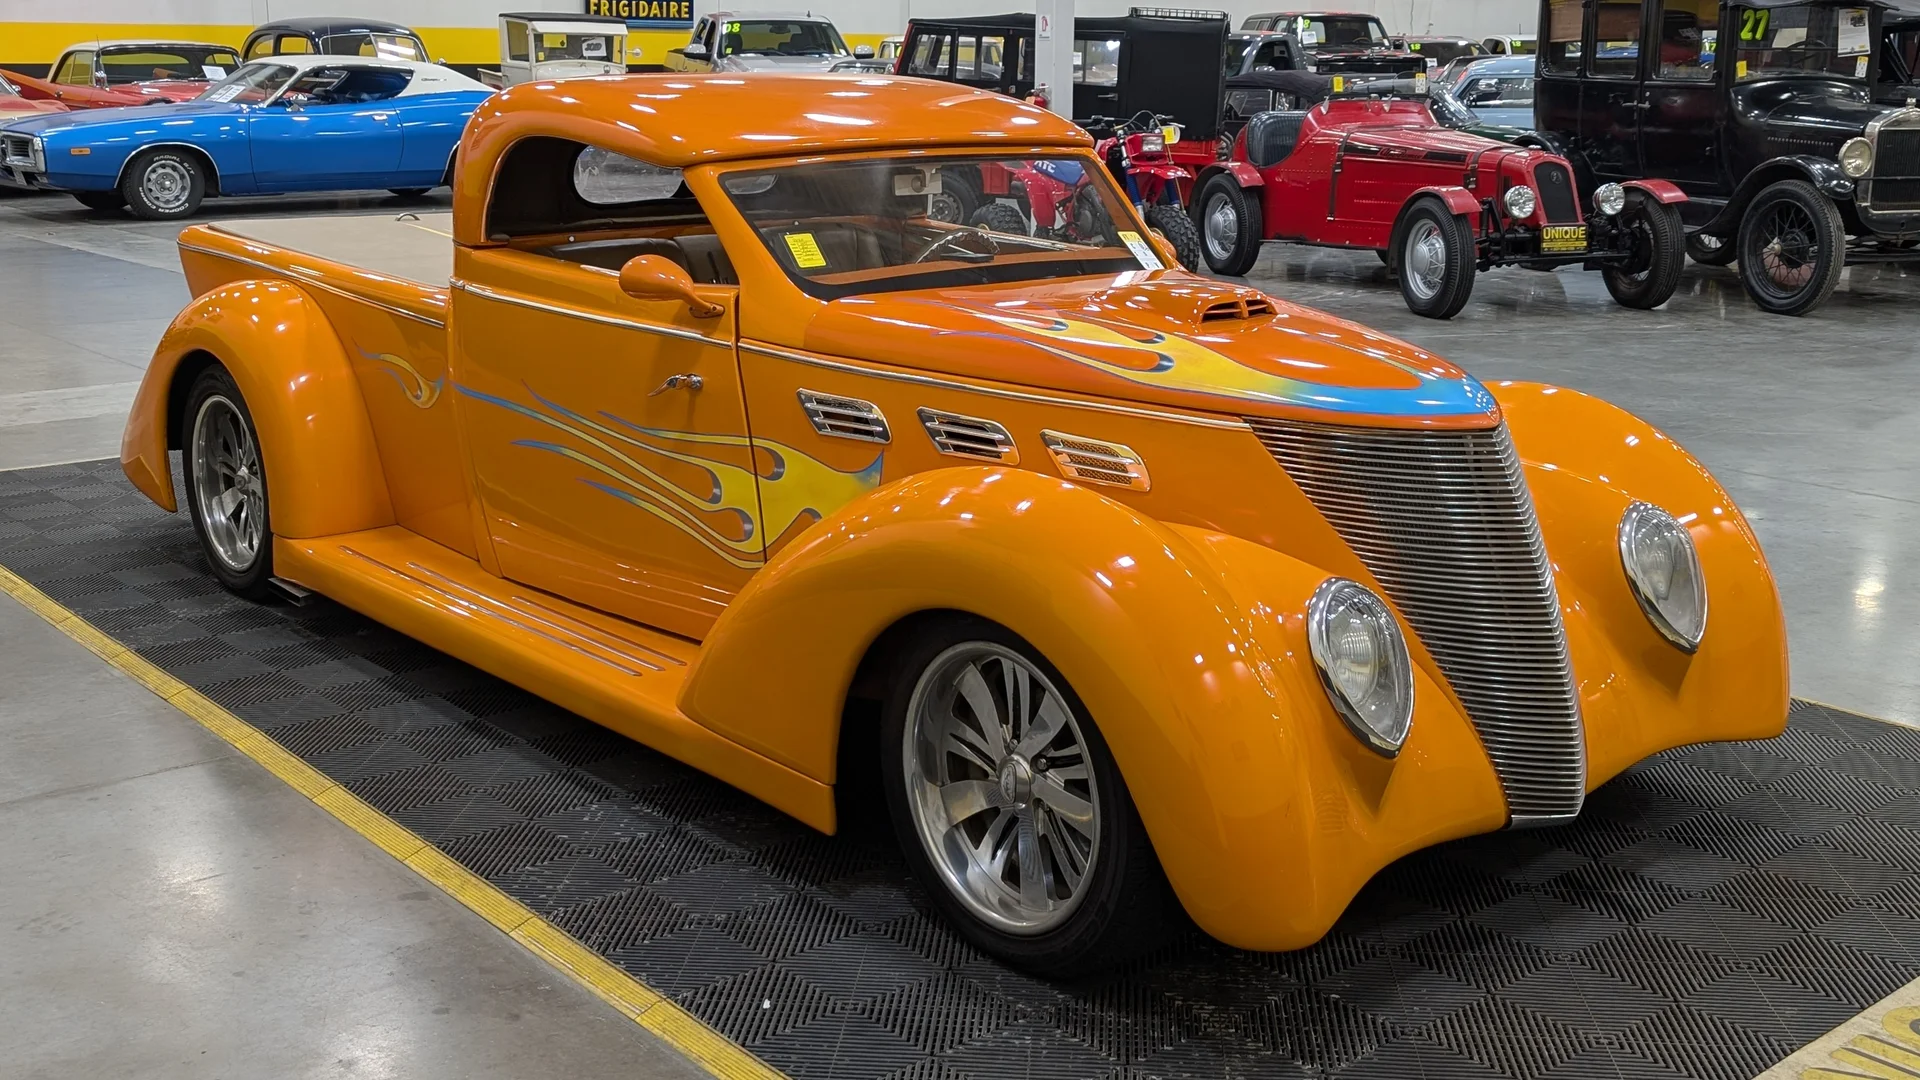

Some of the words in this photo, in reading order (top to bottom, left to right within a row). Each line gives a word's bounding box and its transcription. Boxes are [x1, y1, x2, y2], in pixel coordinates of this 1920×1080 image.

[589, 0, 690, 18] FRIGIDAIRE
[1740, 9, 1769, 41] 27
[158, 202, 189, 213] COOPER
[1543, 226, 1587, 239] UNIQUE
